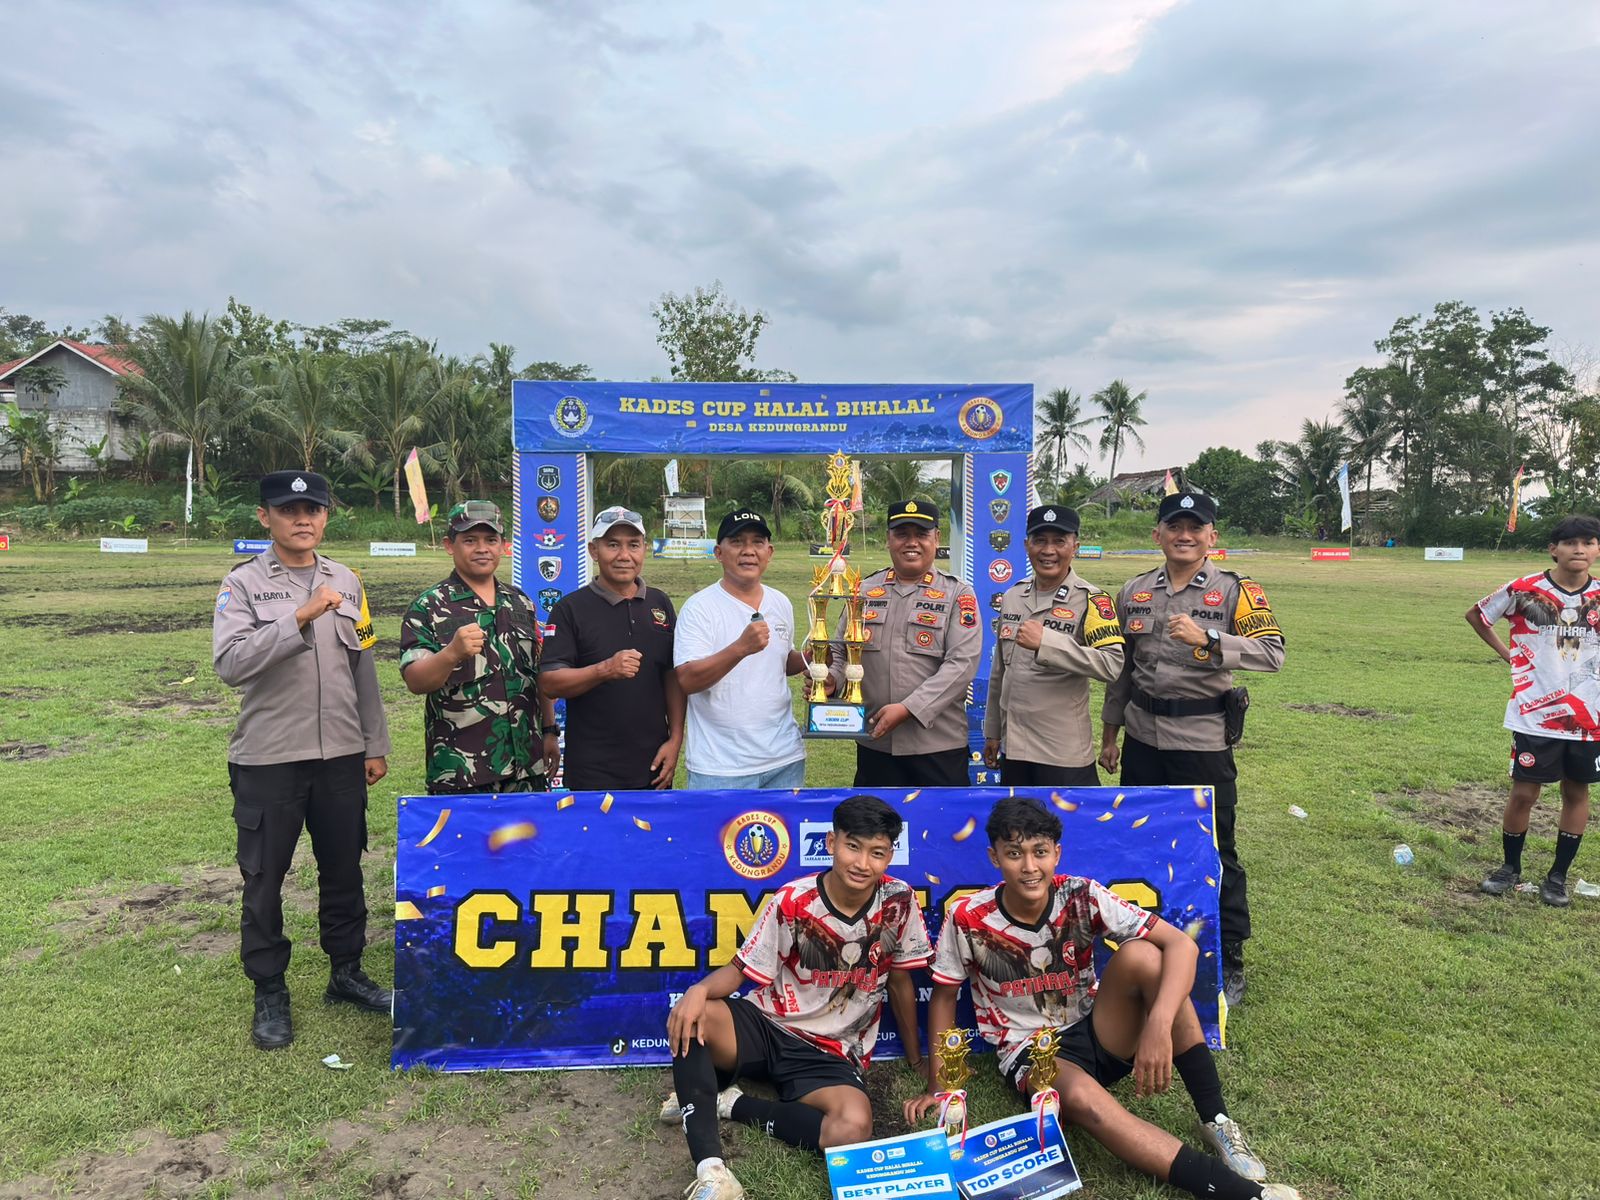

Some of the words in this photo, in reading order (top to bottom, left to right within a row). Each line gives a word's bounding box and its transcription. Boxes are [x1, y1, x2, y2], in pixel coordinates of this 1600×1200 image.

[619, 397, 695, 415] KADES
[702, 401, 746, 417] CUP
[754, 402, 829, 417] HALAL
[836, 399, 935, 416] BIHALAL
[709, 423, 743, 432] DESA
[749, 423, 847, 432] KEDUNGRANDU
[734, 513, 760, 522] LOIS
[338, 591, 356, 604] OLRI
[916, 602, 945, 612] POLRI
[1191, 609, 1223, 621] POLRI
[1043, 619, 1075, 634] POLRI
[737, 814, 760, 826] KADES
[763, 814, 776, 825] CUP
[728, 853, 786, 877] KEDUNGRANDU
[632, 1038, 670, 1048] KEDUN
[967, 1173, 1000, 1191] TOP
[1001, 1149, 1060, 1179] SCORE
[843, 1187, 881, 1199] BEST
[884, 1179, 945, 1195] PLAYER
